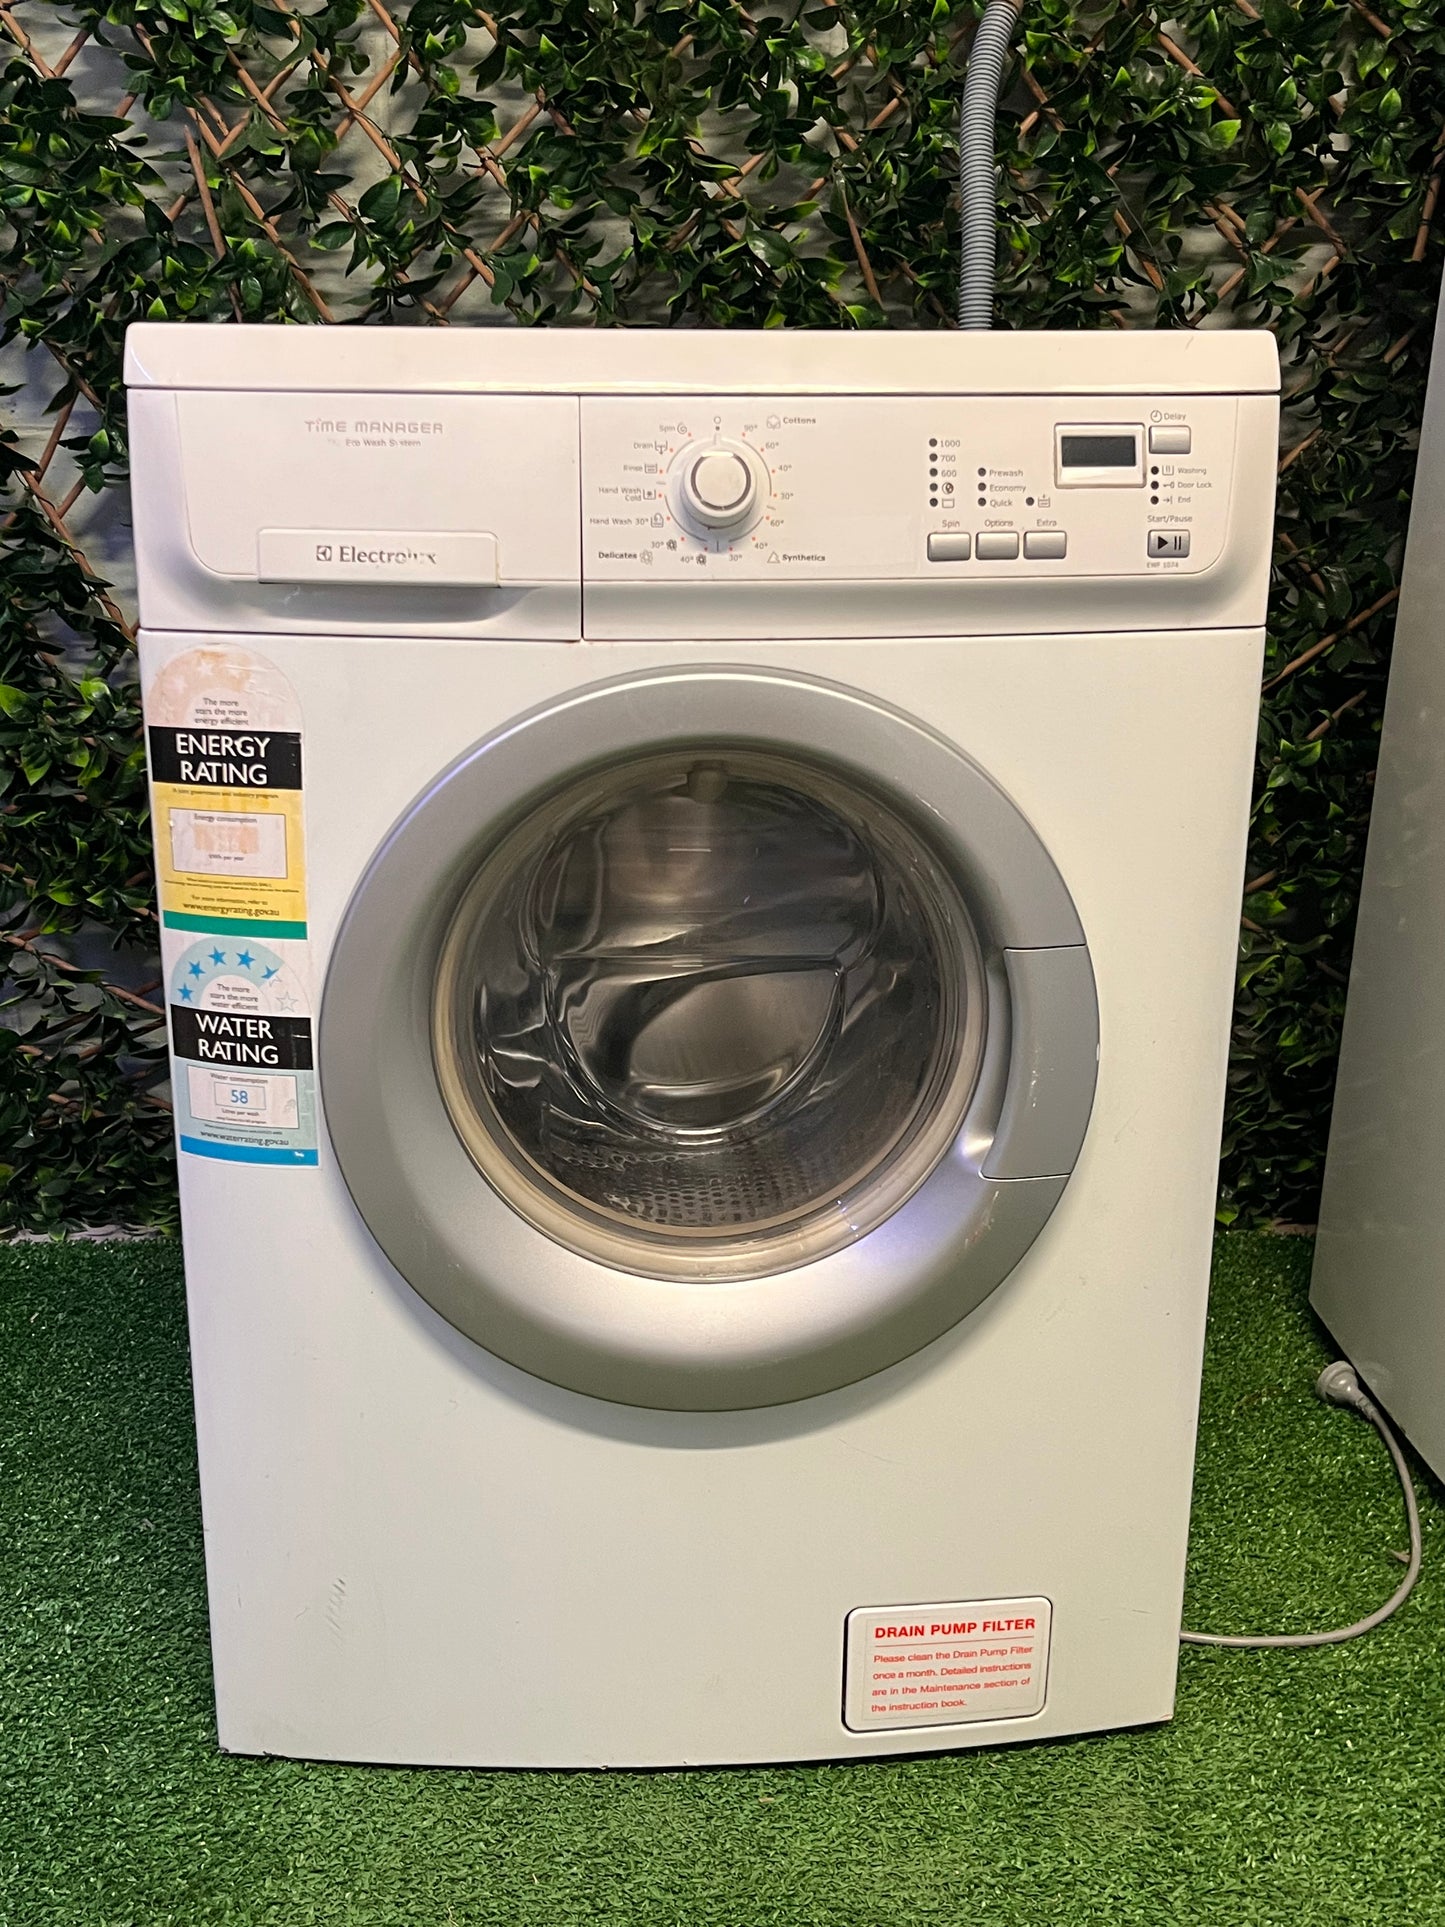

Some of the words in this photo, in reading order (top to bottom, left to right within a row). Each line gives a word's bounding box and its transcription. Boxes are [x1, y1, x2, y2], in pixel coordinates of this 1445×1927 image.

[783, 416, 816, 424] Cottons
[1164, 412, 1187, 421] Delay
[355, 420, 444, 434] MANAGER
[659, 424, 676, 432] Spin
[633, 442, 654, 450] Drain
[765, 442, 779, 450] 60°
[940, 439, 961, 448] 1000
[940, 454, 956, 462] 700
[623, 464, 644, 472] Rinse
[778, 464, 792, 472] 40°
[989, 468, 1024, 477] Prewash
[1177, 466, 1207, 475] Washing
[941, 469, 957, 478] 600
[989, 484, 1026, 493] Economy
[1177, 480, 1194, 489] Door
[1197, 480, 1212, 489] Lock
[598, 487, 618, 495] Hand
[621, 487, 641, 496] Wash
[781, 492, 794, 500] 30°
[625, 494, 642, 502] Cold
[1177, 495, 1192, 504] End
[989, 498, 1013, 508] Quick
[589, 517, 610, 526] Hand
[612, 517, 633, 525] Wash
[984, 518, 1014, 528] Options
[1036, 518, 1058, 527] Extra
[1147, 514, 1193, 523] Start/Pause
[770, 520, 784, 528] 60°
[942, 519, 961, 528] Spin
[754, 542, 768, 550] 40°
[598, 551, 638, 559] Delicates
[729, 553, 742, 562] 30°
[782, 553, 826, 563] Synthetics
[203, 697, 218, 707] The
[220, 699, 239, 707] more
[214, 708, 227, 717] the
[228, 709, 248, 717] more
[194, 717, 219, 726] energy
[220, 717, 249, 726] efficient
[175, 732, 271, 758] ENERGY
[180, 760, 268, 785] RATING
[217, 983, 230, 992] The
[227, 993, 239, 1001] the
[240, 995, 259, 1003] more
[231, 1002, 259, 1011] efficient
[195, 1013, 274, 1039] WATER
[198, 1039, 279, 1065] RATING
[231, 1089, 249, 1104] 58
[874, 1625, 926, 1639] DRAIN
[930, 1622, 978, 1636] PUMP
[982, 1618, 1036, 1633] FILTER
[873, 1654, 906, 1663] Please
[908, 1653, 934, 1662] clean
[936, 1652, 951, 1660] the
[953, 1649, 978, 1658] Drain
[980, 1648, 1008, 1658] Pump
[1010, 1646, 1034, 1655] Filter
[873, 1671, 896, 1680] once
[906, 1669, 938, 1678] month.
[940, 1666, 978, 1676] Detailed
[980, 1662, 1032, 1673] instructions
[872, 1688, 887, 1696] are
[890, 1687, 899, 1695] in
[902, 1685, 918, 1694] the
[920, 1681, 981, 1693] Maintenance
[984, 1679, 1019, 1688] section
[1020, 1676, 1031, 1686] of
[871, 1702, 888, 1712] the
[889, 1700, 939, 1711] instruction
[941, 1698, 967, 1708] book.
